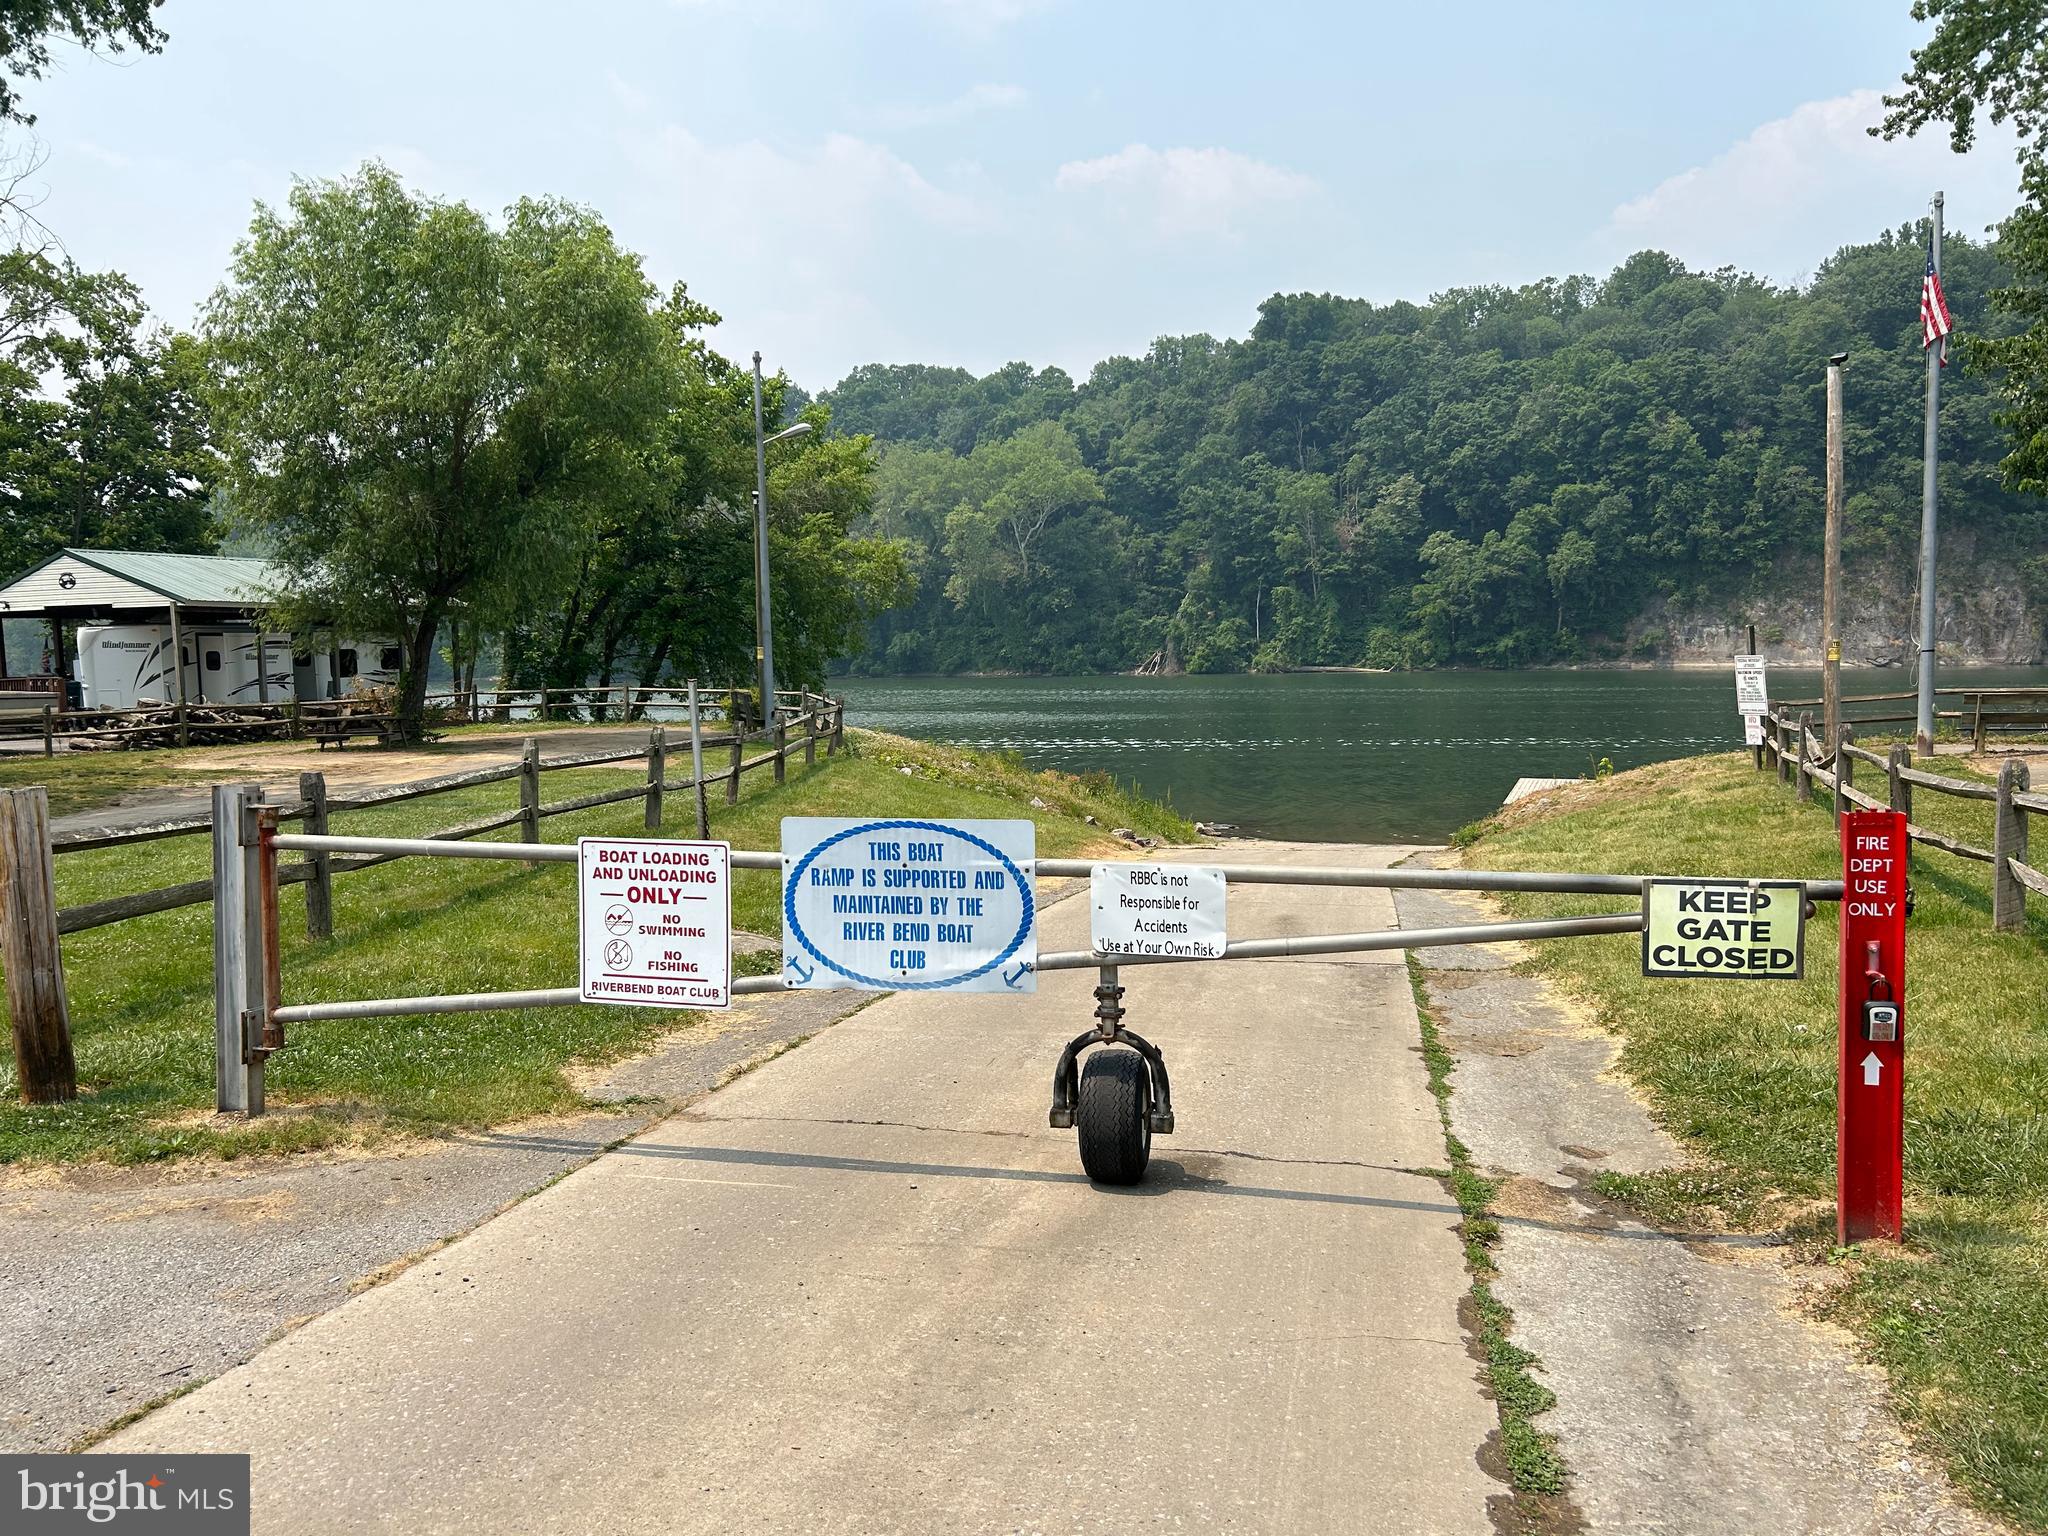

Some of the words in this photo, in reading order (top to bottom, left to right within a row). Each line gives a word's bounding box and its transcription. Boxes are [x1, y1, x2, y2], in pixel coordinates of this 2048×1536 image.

[1856, 836, 1889, 850] FIRE
[600, 850, 638, 864] BOAT
[642, 852, 710, 866] LOADING
[868, 842, 900, 862] THIS
[908, 842, 944, 862] BOAT
[1850, 859, 1893, 872] DEPT
[592, 867, 623, 880] AND
[628, 868, 716, 884] UNLOADING
[811, 868, 854, 887] RAMP
[862, 868, 876, 887] IS
[884, 868, 966, 890] SUPPORTED
[974, 871, 1005, 890] AND
[1130, 871, 1158, 885] RBBC
[1160, 873, 1168, 886] is
[1170, 874, 1188, 887] not
[627, 886, 682, 904] ONLY
[1855, 880, 1887, 894] USE
[833, 894, 923, 915] MAINTAINED
[931, 896, 948, 916] BY
[957, 897, 983, 917] THE
[1120, 894, 1180, 911] Responsible
[1183, 896, 1200, 910] for
[1679, 890, 1771, 914] KEEP
[1848, 902, 1896, 916] ONLY
[662, 914, 680, 924] NO
[1134, 918, 1188, 933] Accidents
[638, 925, 706, 938] SWIMMING
[843, 922, 885, 941] RIVER
[893, 922, 930, 942] BEND
[937, 923, 974, 943] BOAT
[1677, 918, 1771, 942] GATE
[1102, 938, 1121, 952] Use
[1123, 941, 1134, 952] at
[1136, 940, 1162, 954] Your
[1165, 941, 1191, 955] Own
[1193, 942, 1214, 956] Risk
[664, 951, 682, 960] NO
[890, 950, 926, 970] CLUB
[1653, 945, 1794, 969] CLOSED
[648, 961, 698, 972] FISHING
[592, 982, 654, 994] RIVERBEND
[658, 985, 686, 996] BOAT
[690, 988, 719, 998] CLUB
